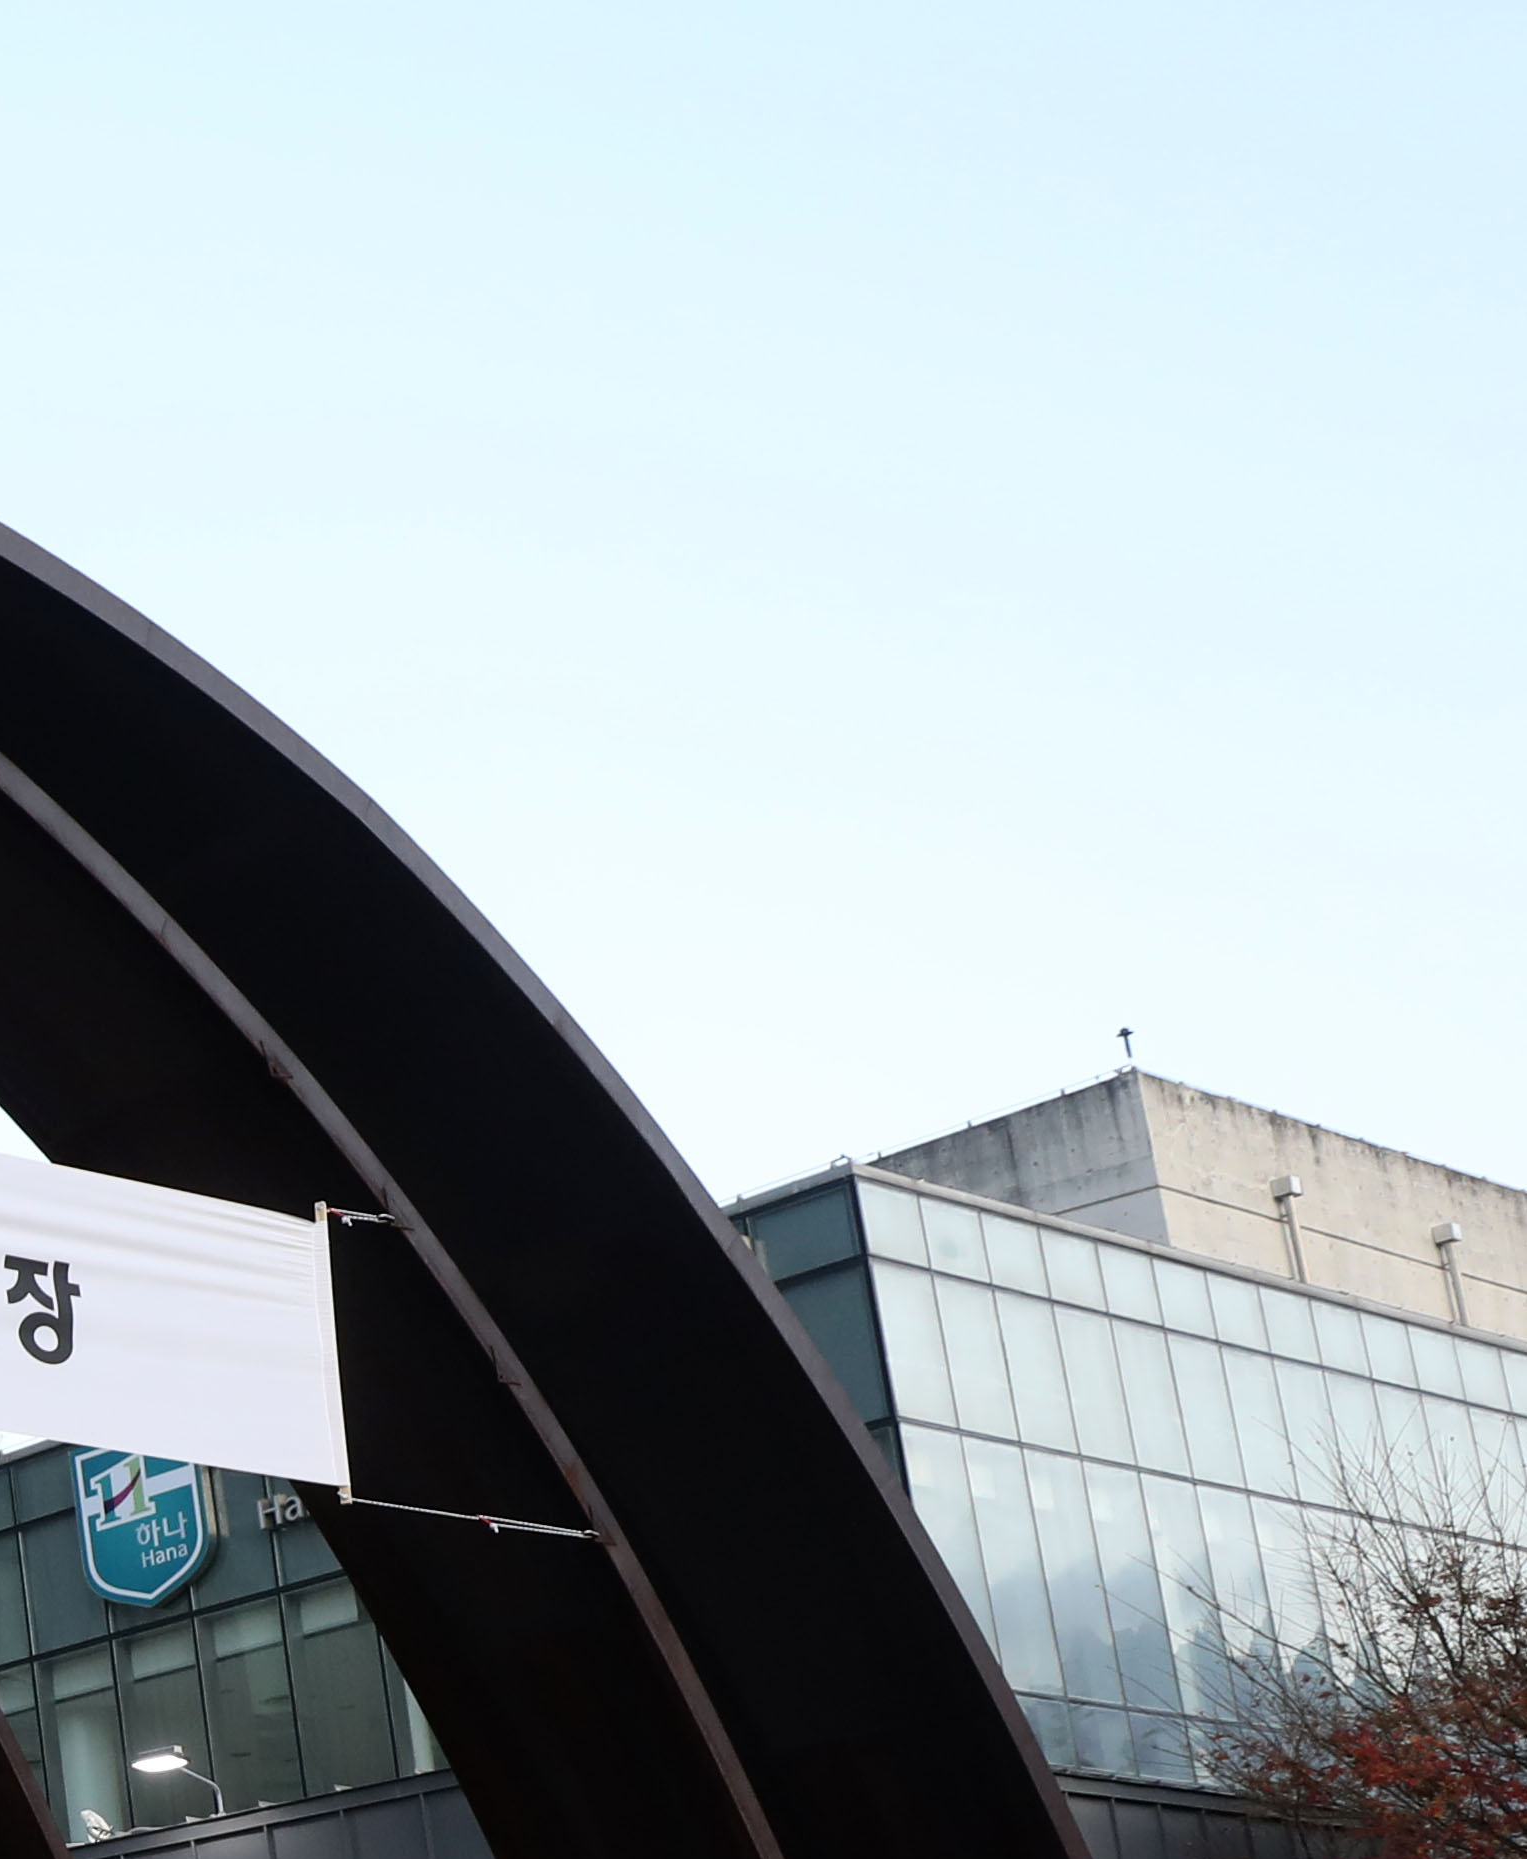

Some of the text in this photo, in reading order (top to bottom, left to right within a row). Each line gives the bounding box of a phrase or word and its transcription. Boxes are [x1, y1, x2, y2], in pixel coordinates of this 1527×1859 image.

[135, 1511, 188, 1547] 하나
[257, 1493, 310, 1529] Ha
[142, 1543, 188, 1568] Hana
